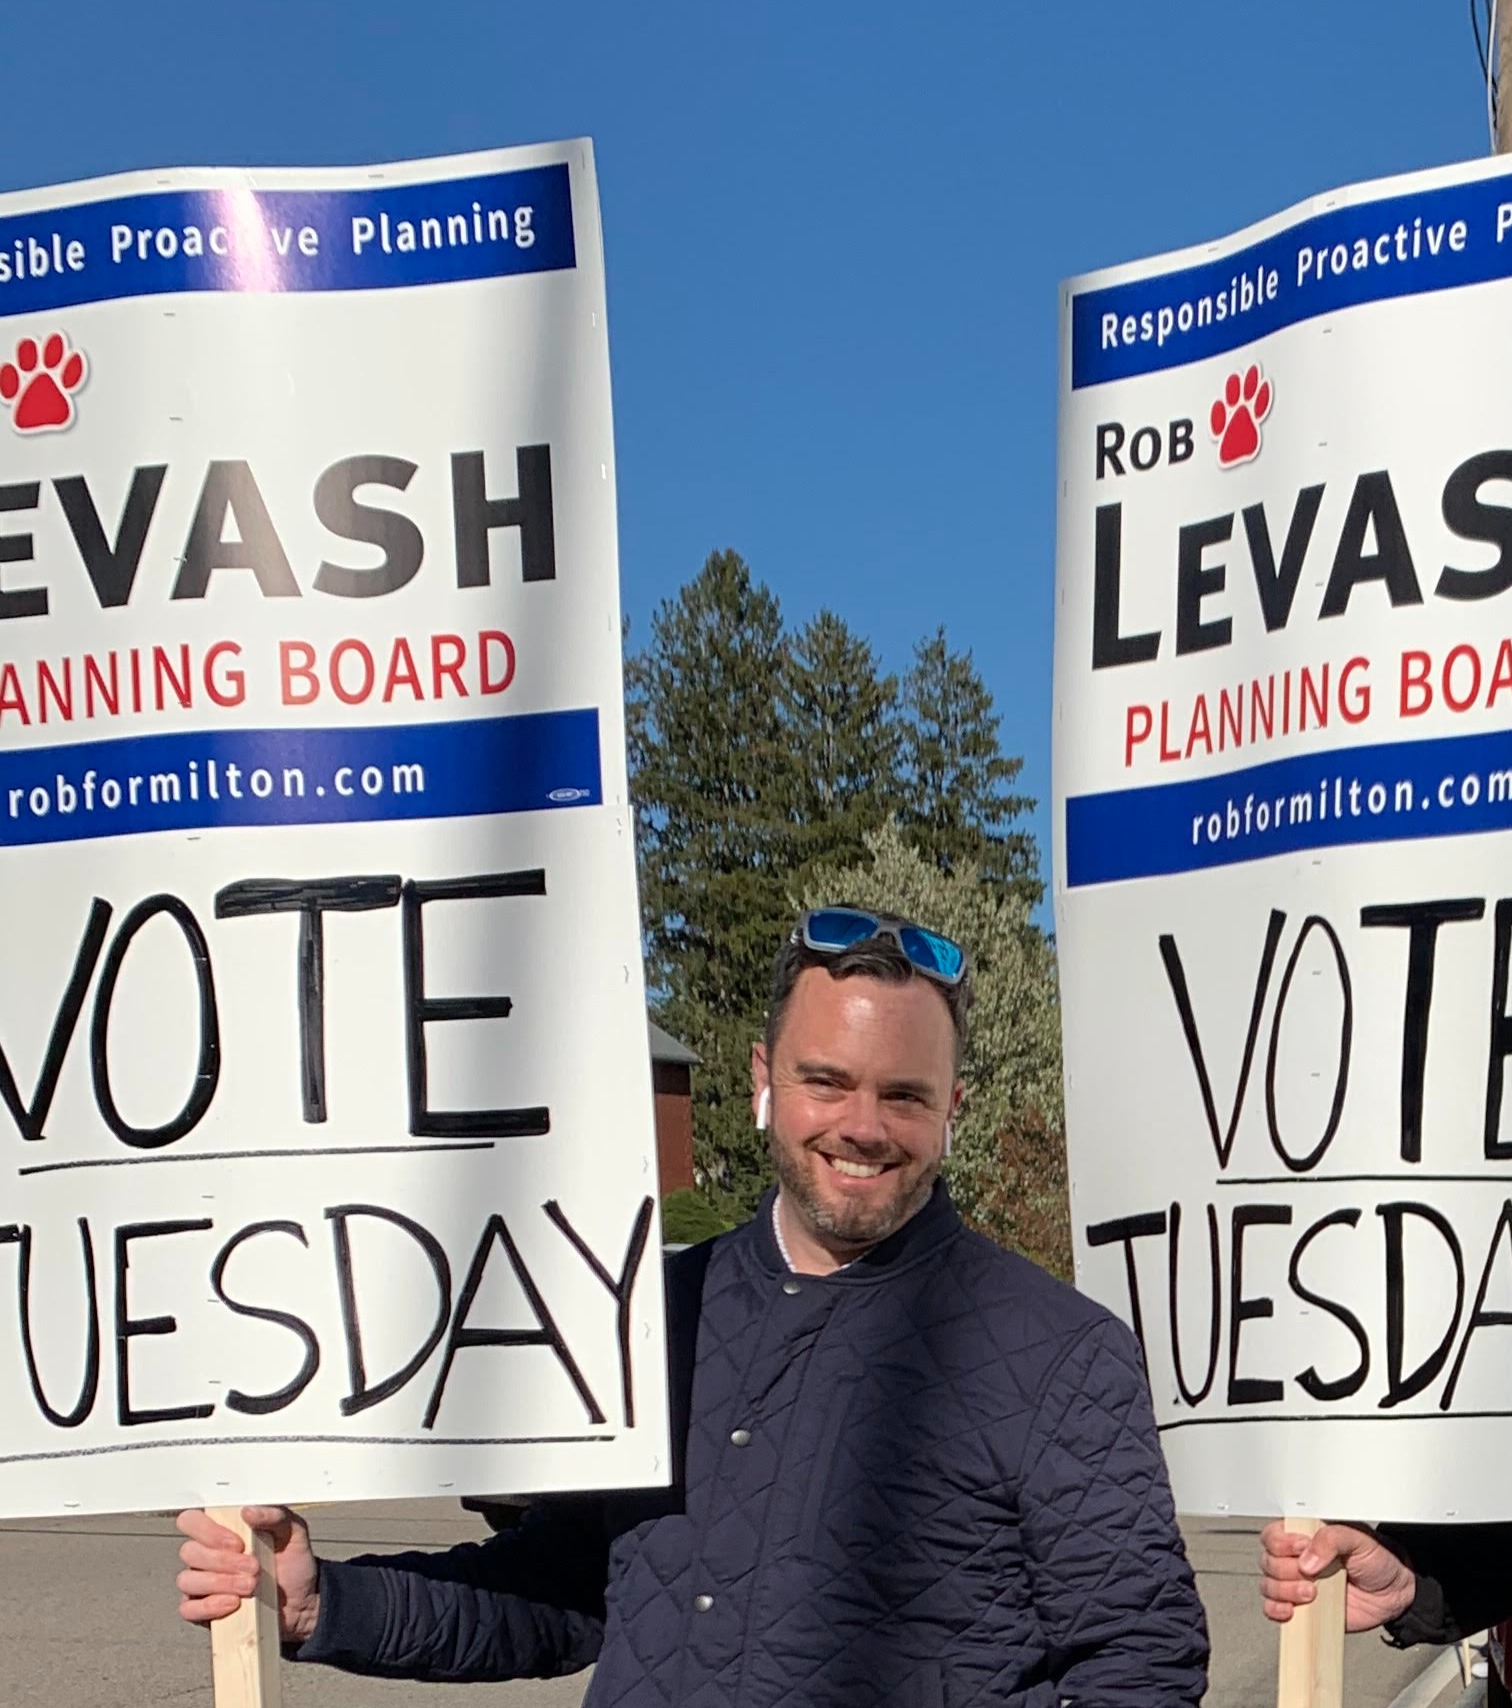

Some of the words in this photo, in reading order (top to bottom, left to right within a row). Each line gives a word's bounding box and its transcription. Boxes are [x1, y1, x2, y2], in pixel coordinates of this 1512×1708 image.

[111, 224, 319, 264] Proacve
[352, 201, 536, 256] Planning
[1101, 265, 1280, 350] Responsible
[1297, 215, 1468, 286] Proactive
[279, 629, 517, 706] BOARD
[1124, 656, 1372, 767] PLANNING
[8, 759, 425, 818] robformilton.com
